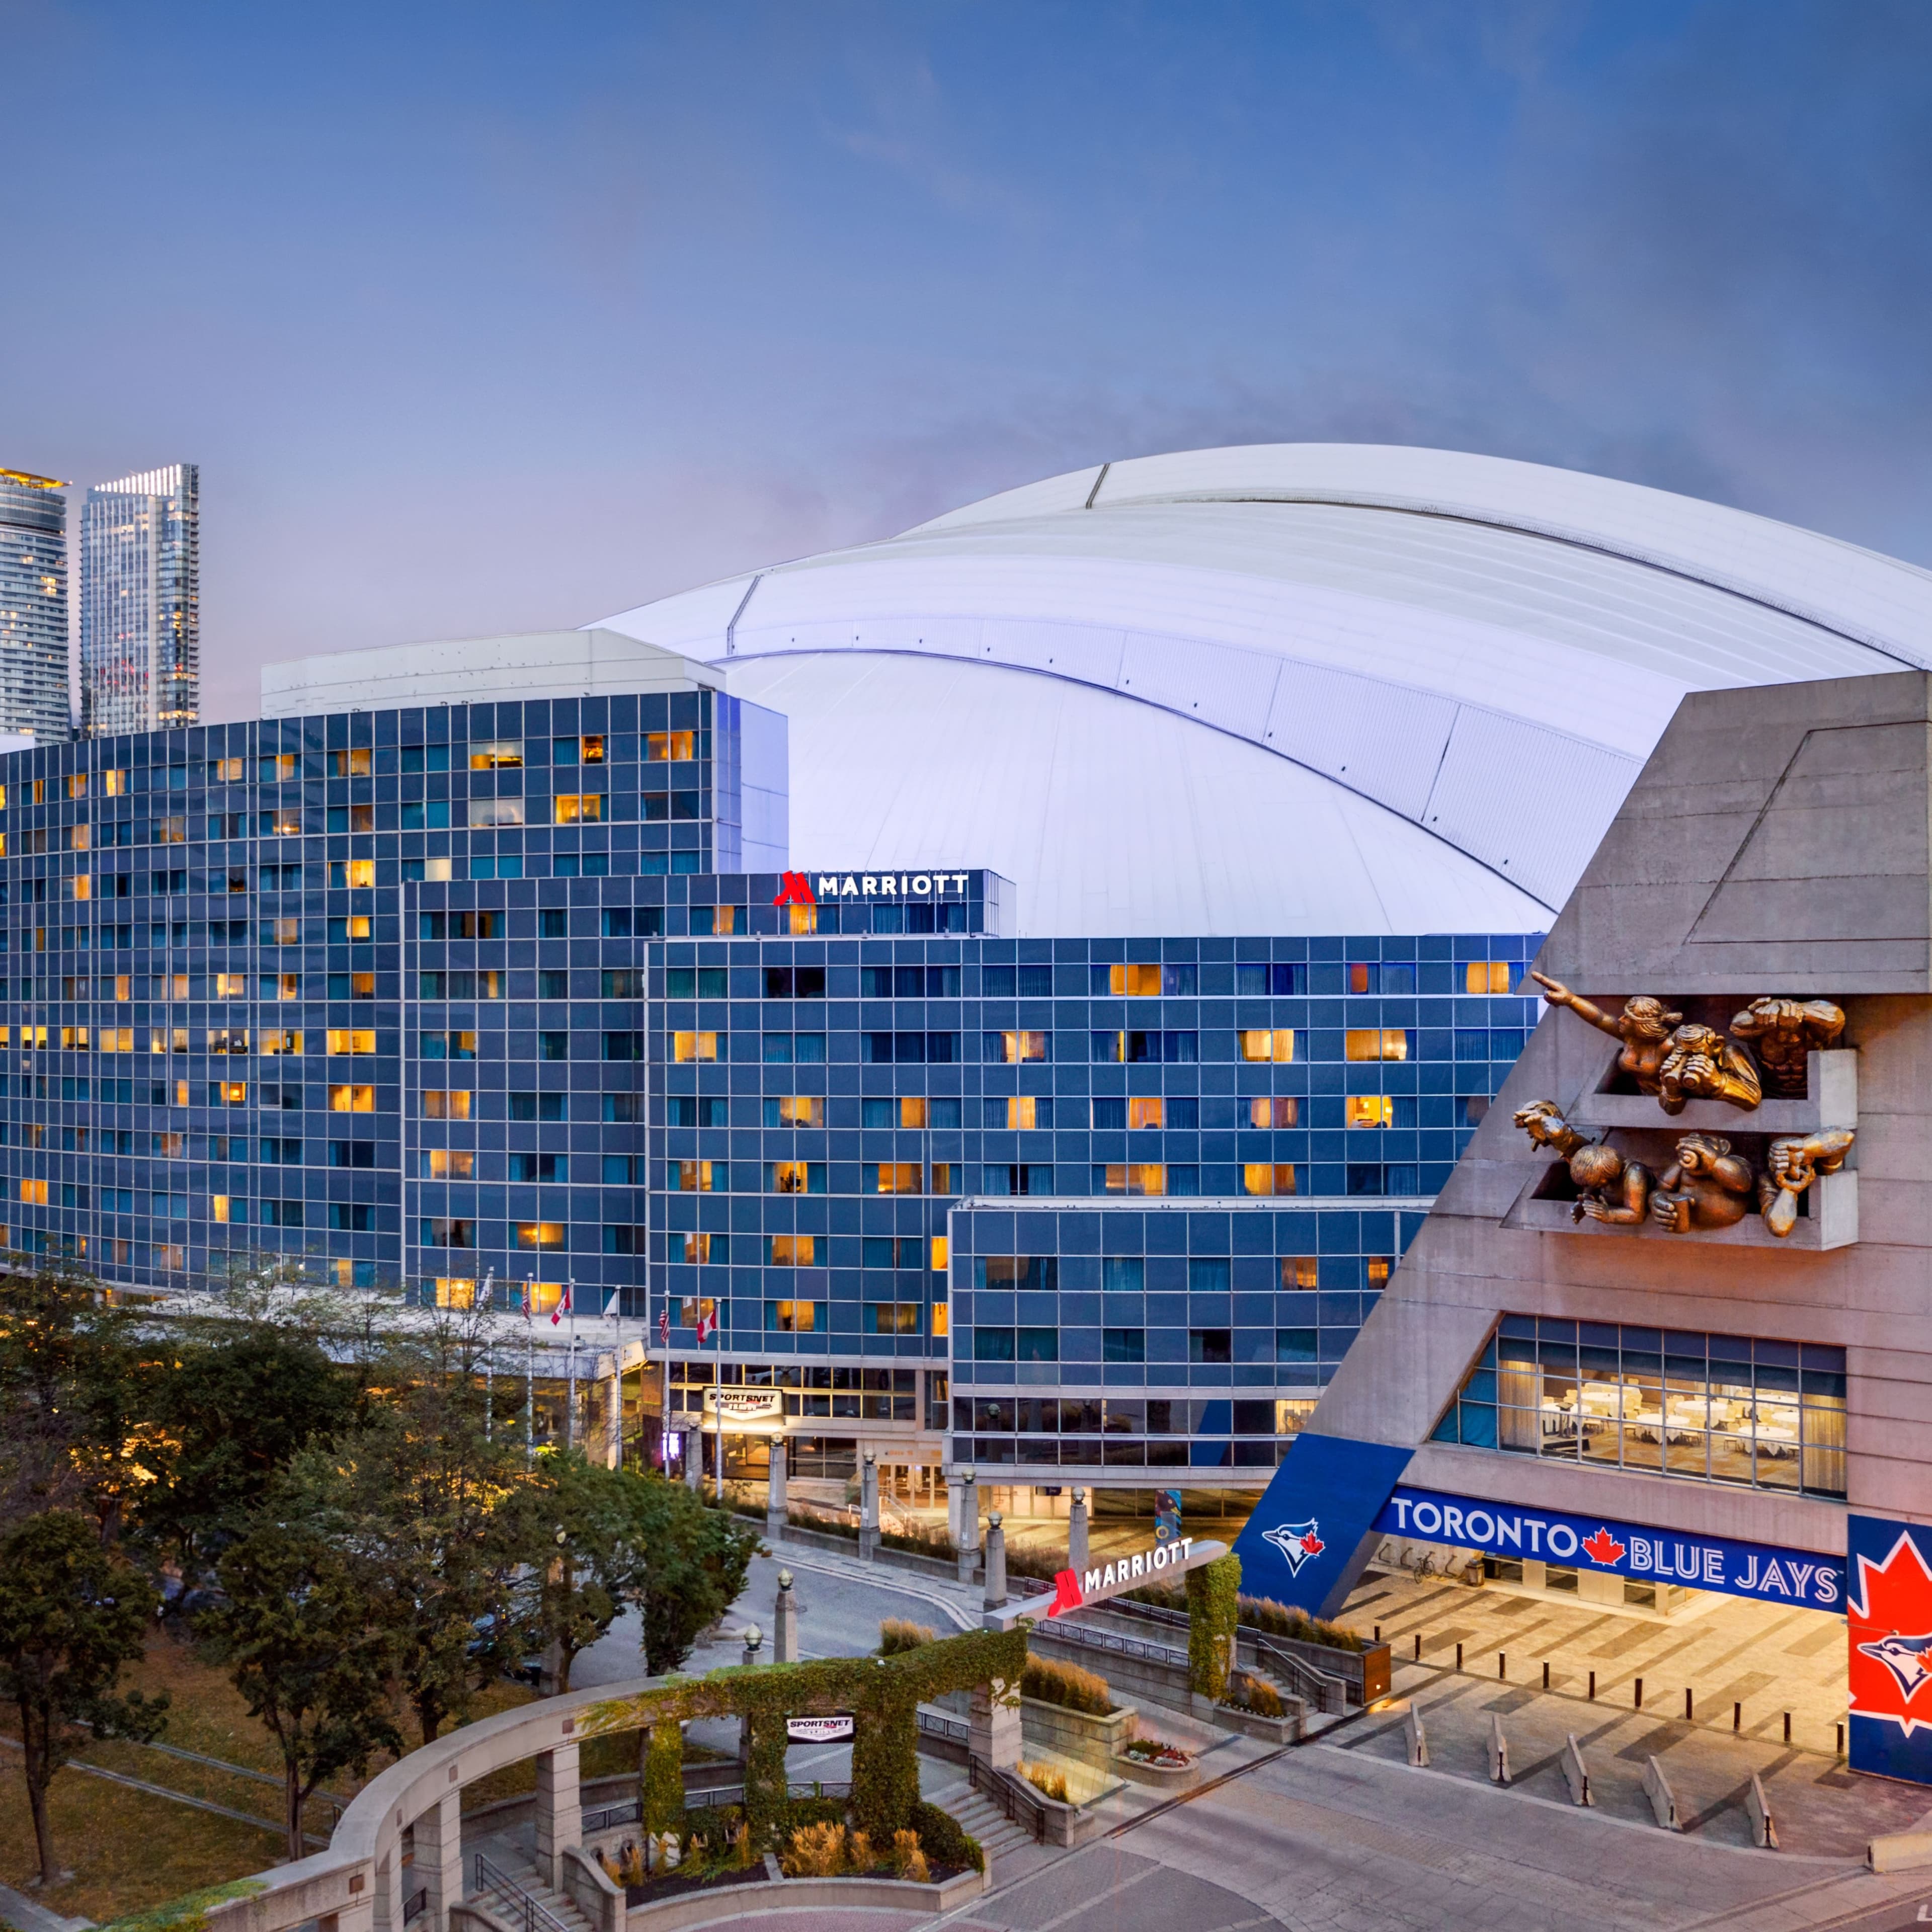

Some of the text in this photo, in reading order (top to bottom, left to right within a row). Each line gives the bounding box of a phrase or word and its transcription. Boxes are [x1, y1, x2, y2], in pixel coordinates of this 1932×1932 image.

[819, 874, 969, 896] MARRIOTT
[1391, 1497, 1578, 1558] TORONTO
[1630, 1536, 1725, 1585] BLUE
[1085, 1537, 1193, 1594] MARRIOTT
[790, 1720, 850, 1728] SPORTSNET
